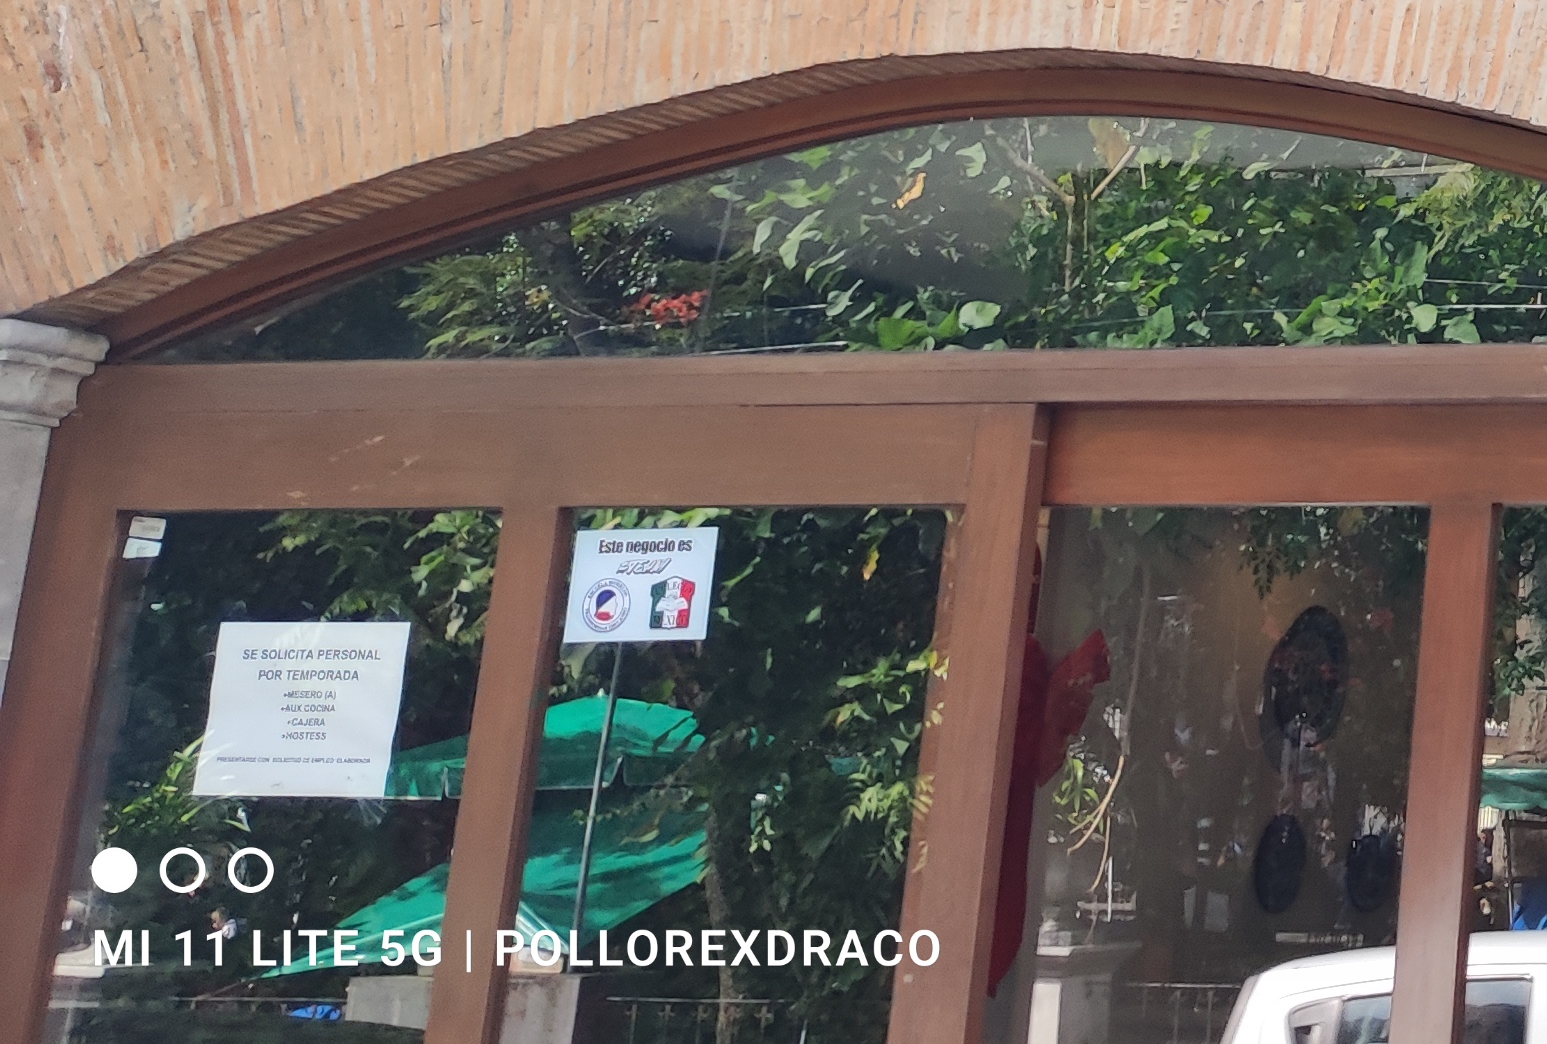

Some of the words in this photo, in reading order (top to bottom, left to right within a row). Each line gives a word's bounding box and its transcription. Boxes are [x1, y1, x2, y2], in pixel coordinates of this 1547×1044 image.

[598, 539, 623, 553] Este
[626, 538, 675, 554] negocio
[678, 539, 693, 552] es
[242, 649, 258, 660] SE
[260, 649, 314, 660] SOLICITA
[317, 649, 381, 660] PERSONAL
[257, 669, 282, 681] POR
[286, 669, 359, 681] TEMPORADA
[324, 691, 337, 700] (A)
[303, 704, 336, 713] COCINA
